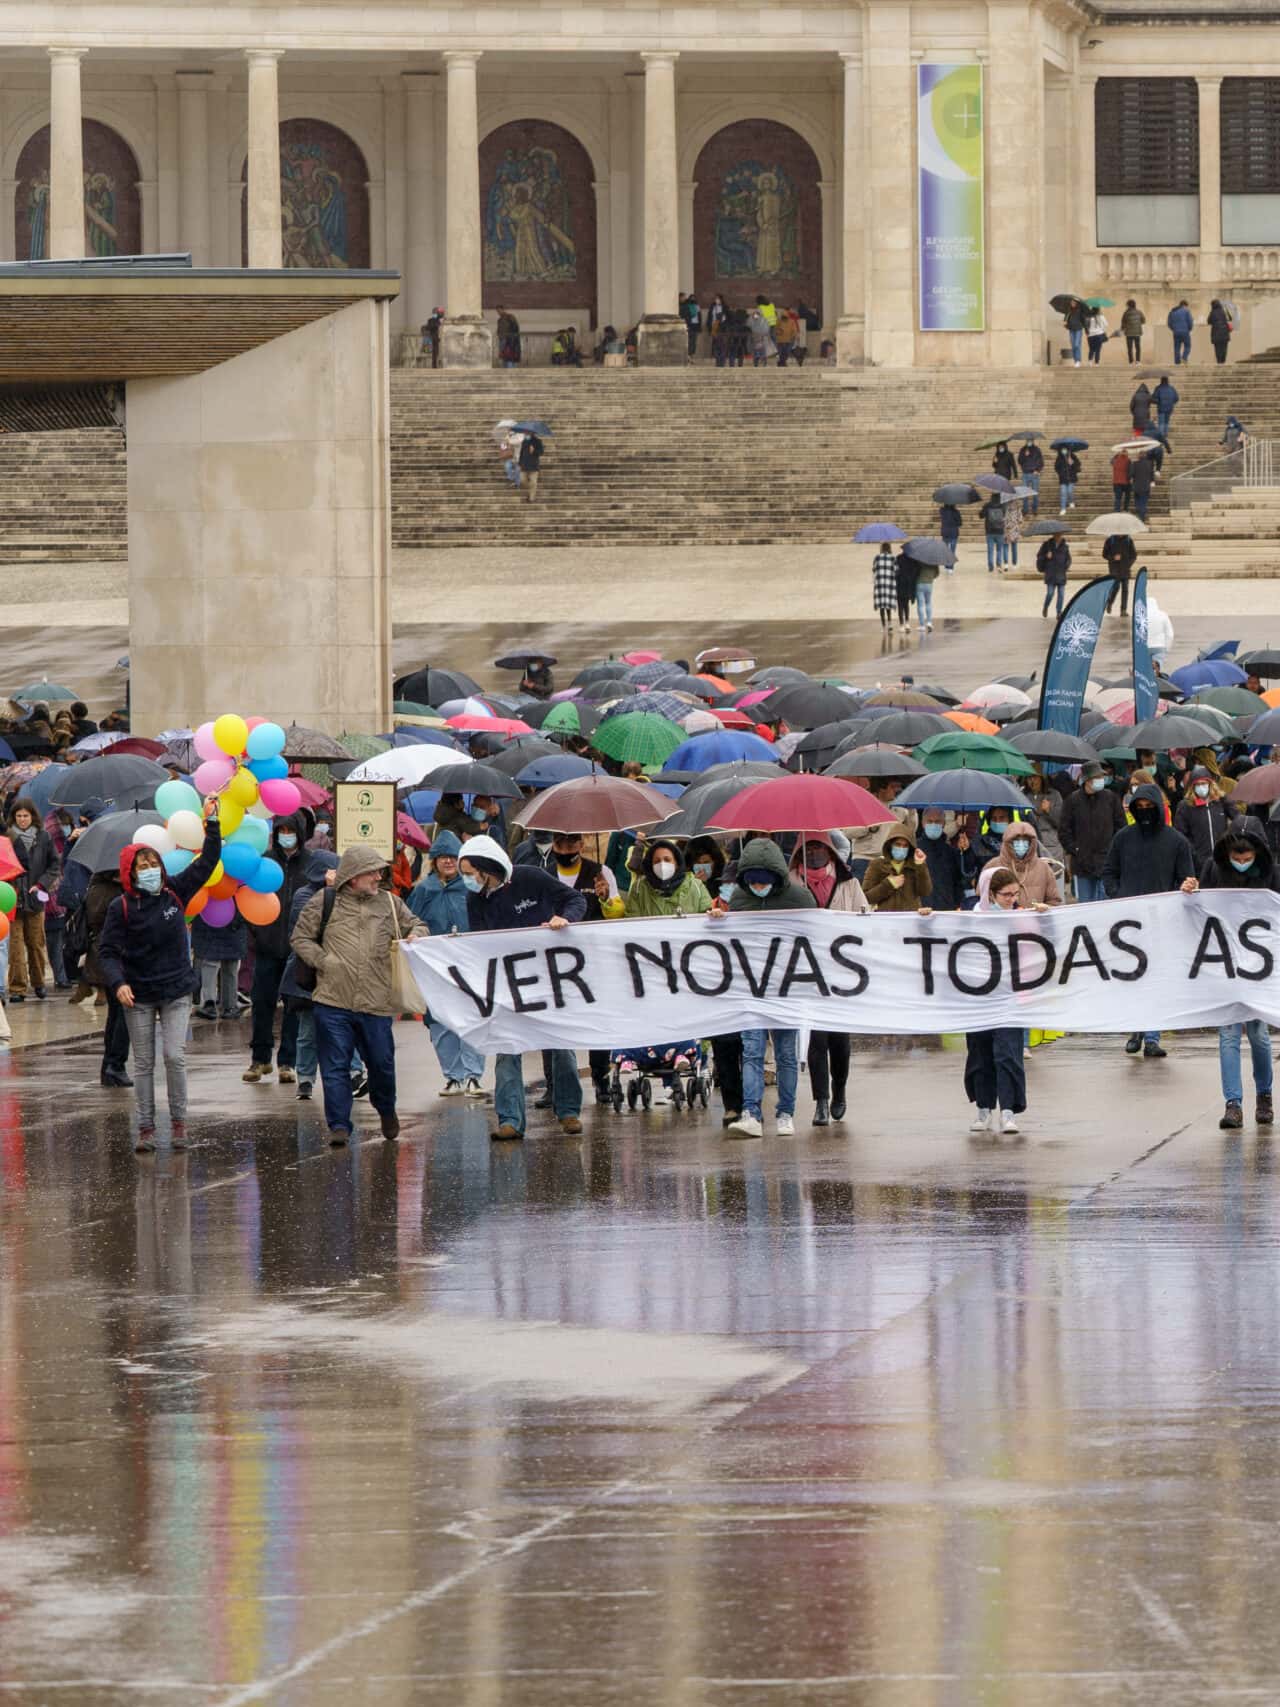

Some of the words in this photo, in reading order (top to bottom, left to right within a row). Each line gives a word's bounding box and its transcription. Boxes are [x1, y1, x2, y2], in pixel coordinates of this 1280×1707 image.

[448, 945, 596, 1018] VER
[625, 935, 869, 998] NOVAS
[903, 919, 1148, 996] TODAS
[1188, 916, 1275, 981] AS
